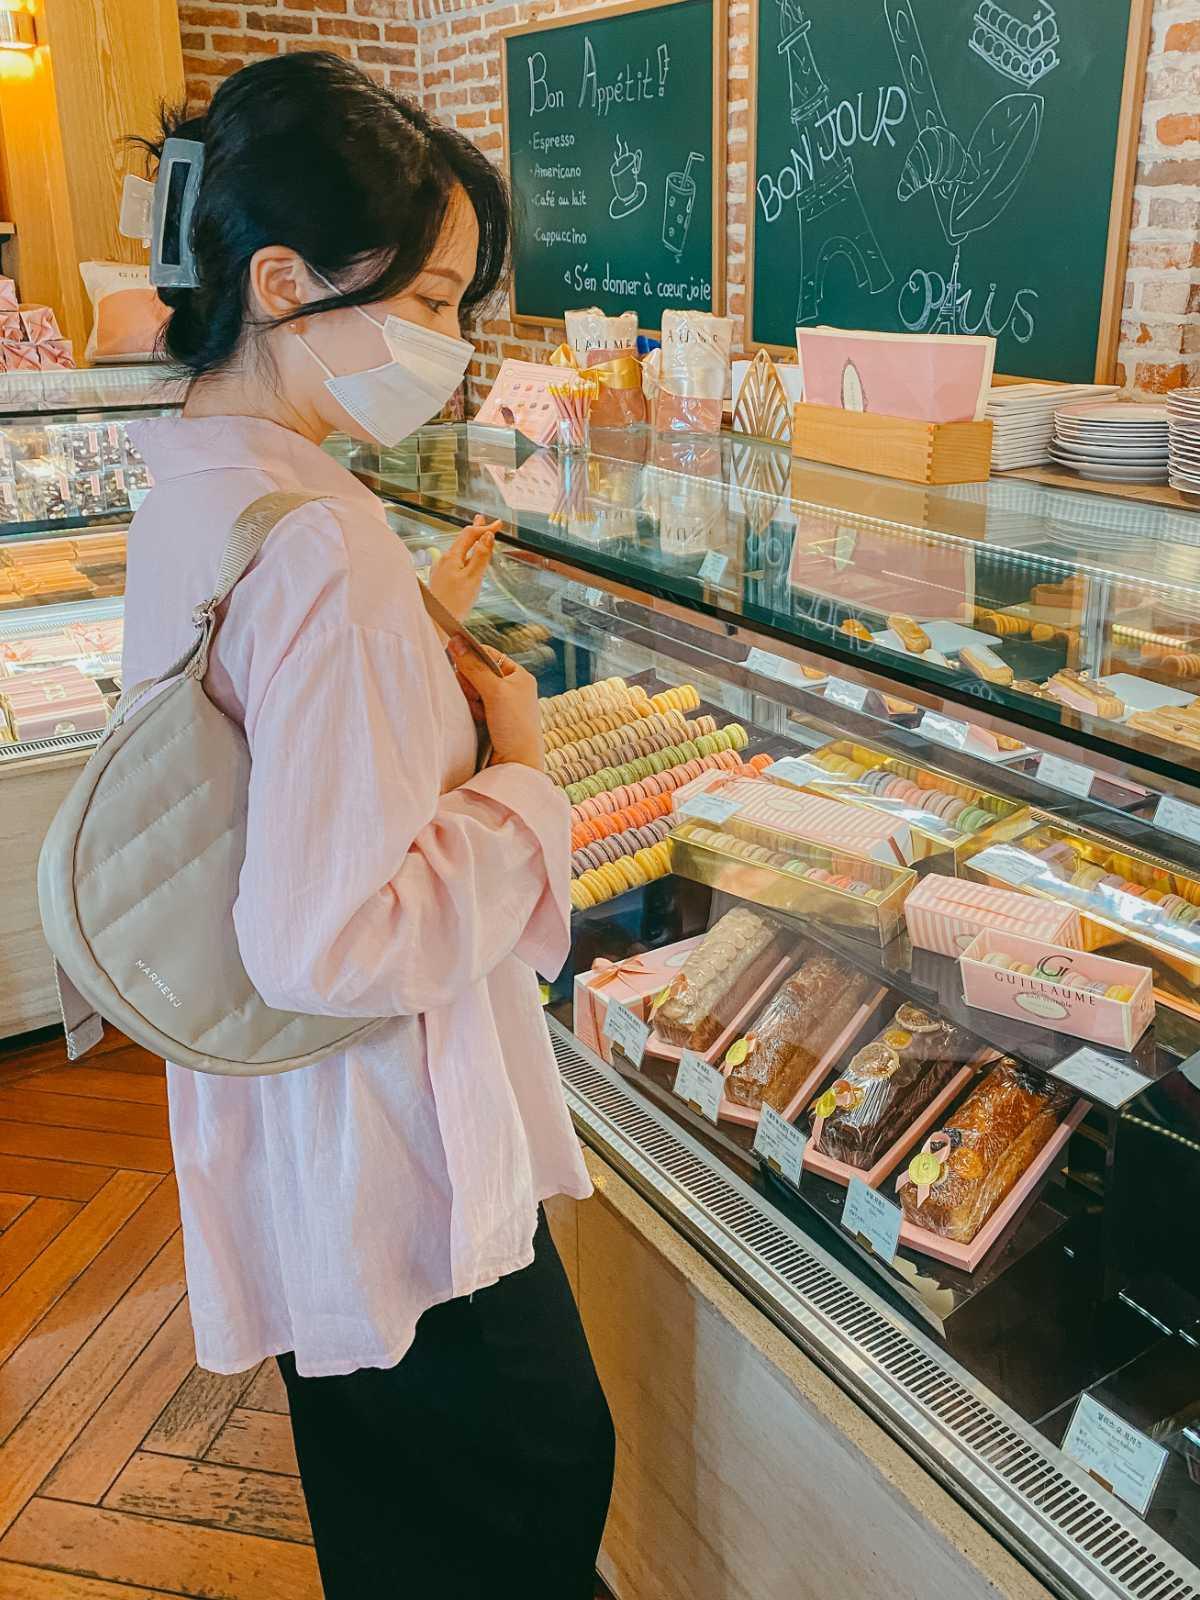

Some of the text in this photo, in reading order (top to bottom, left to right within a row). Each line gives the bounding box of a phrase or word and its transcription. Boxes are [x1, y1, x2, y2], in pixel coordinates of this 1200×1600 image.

[527, 51, 565, 117] Bon
[533, 131, 575, 154] Espresso
[534, 162, 582, 179] Americano
[757, 133, 814, 223] BON
[535, 227, 587, 248] Cappuccino
[602, 262, 642, 296] donner
[686, 275, 712, 301] joie
[994, 971, 1097, 1007] GUILLAUME
